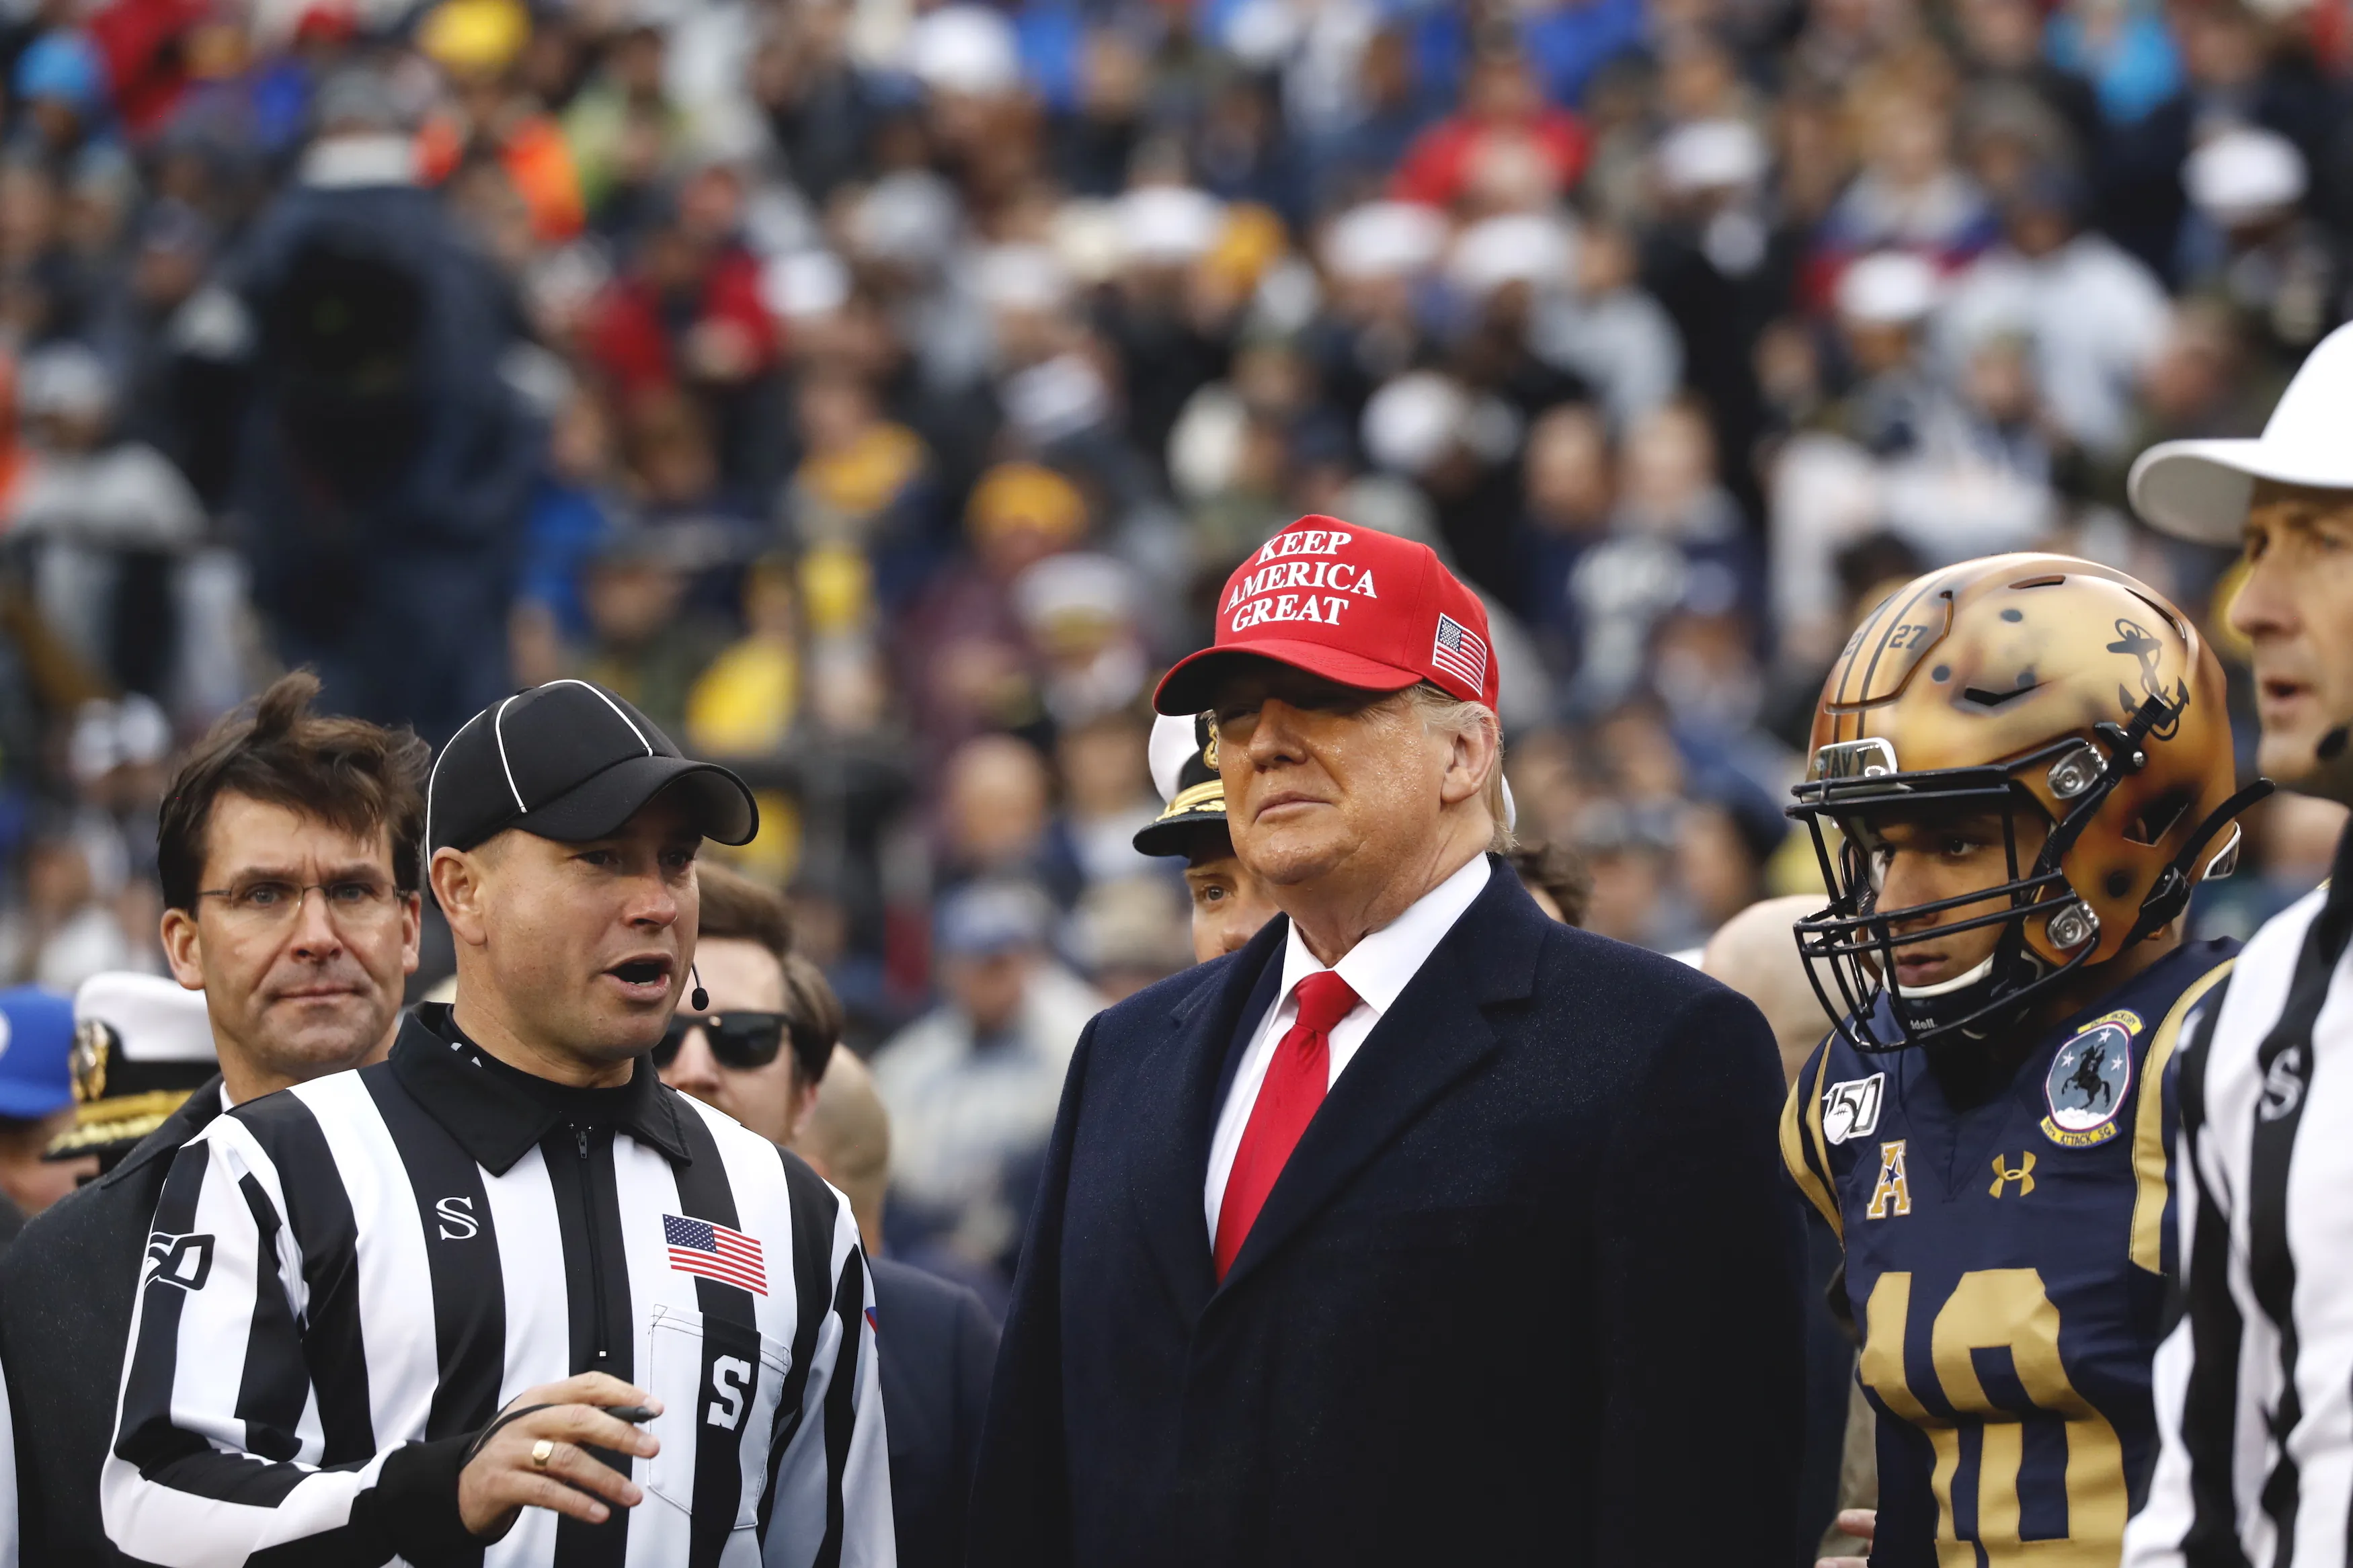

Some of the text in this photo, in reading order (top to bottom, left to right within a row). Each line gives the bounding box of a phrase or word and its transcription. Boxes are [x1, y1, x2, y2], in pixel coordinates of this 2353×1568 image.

[1255, 530, 1351, 566] KEEP
[1224, 561, 1378, 614] AMERICA
[1232, 594, 1349, 632] GREAT
[1888, 624, 1928, 649] 27
[2260, 1045, 2304, 1123] S
[2060, 1131, 2092, 1145] ATTACK
[1866, 1139, 1911, 1221] A
[436, 1196, 479, 1241] S
[707, 1354, 751, 1431] S
[1859, 1268, 2128, 1568] 10
